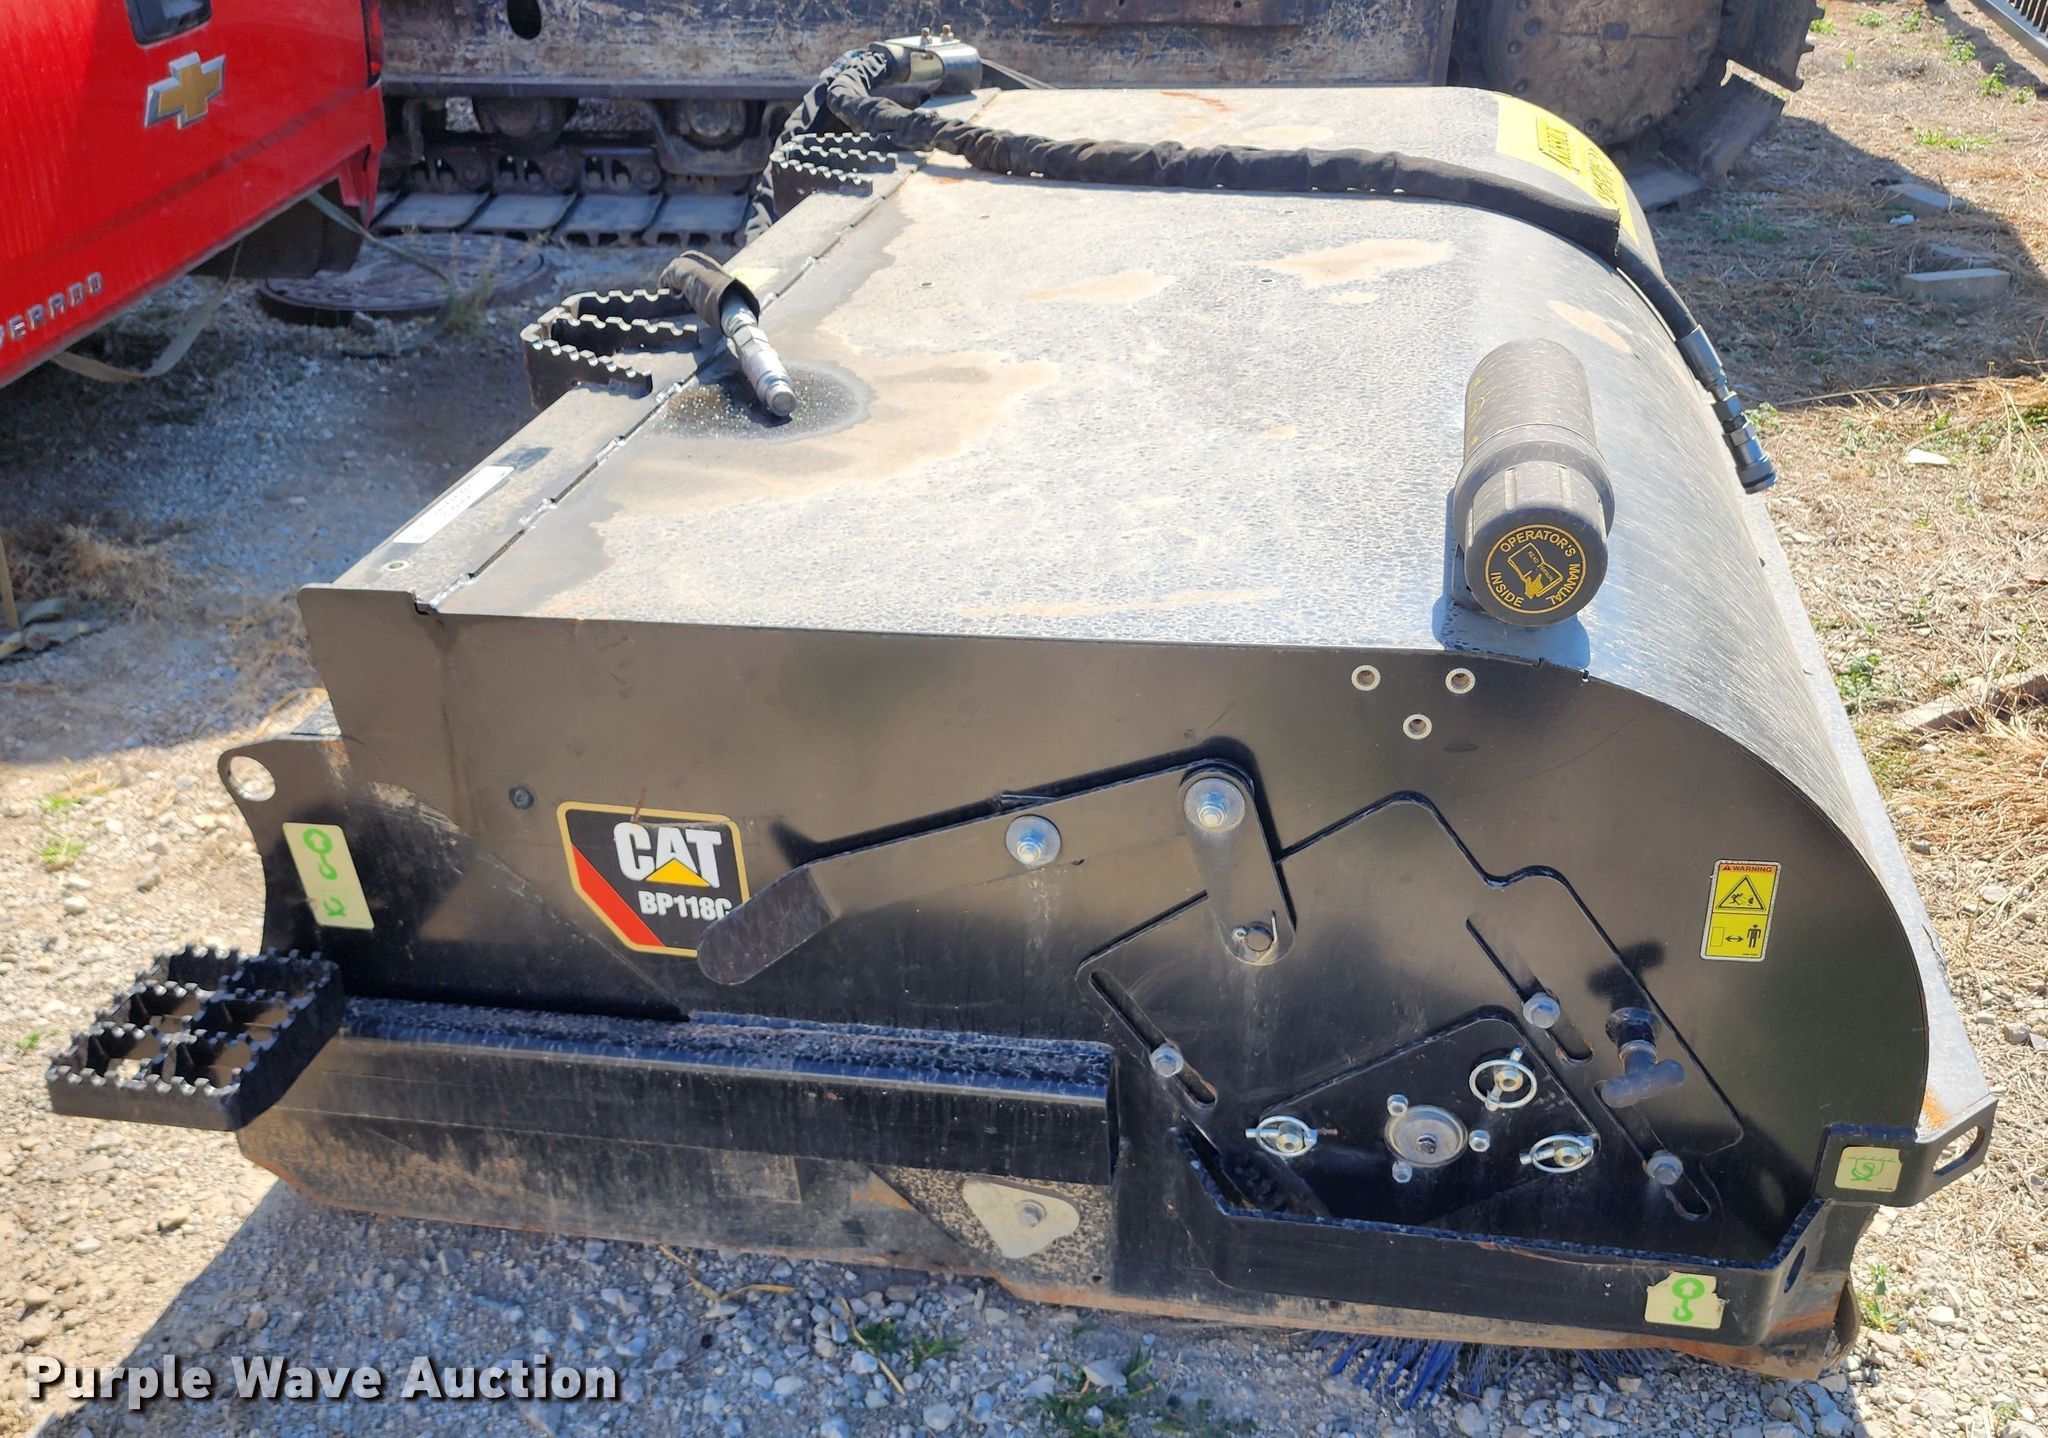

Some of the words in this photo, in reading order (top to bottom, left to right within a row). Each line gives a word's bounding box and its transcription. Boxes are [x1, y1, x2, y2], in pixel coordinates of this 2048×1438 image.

[1490, 571, 1525, 608] INSIDE
[1499, 529, 1577, 558] OPERATOR'S
[1545, 562, 1581, 606] MANUAL
[613, 822, 722, 889] CAT
[1732, 865, 1773, 873] WARNING
